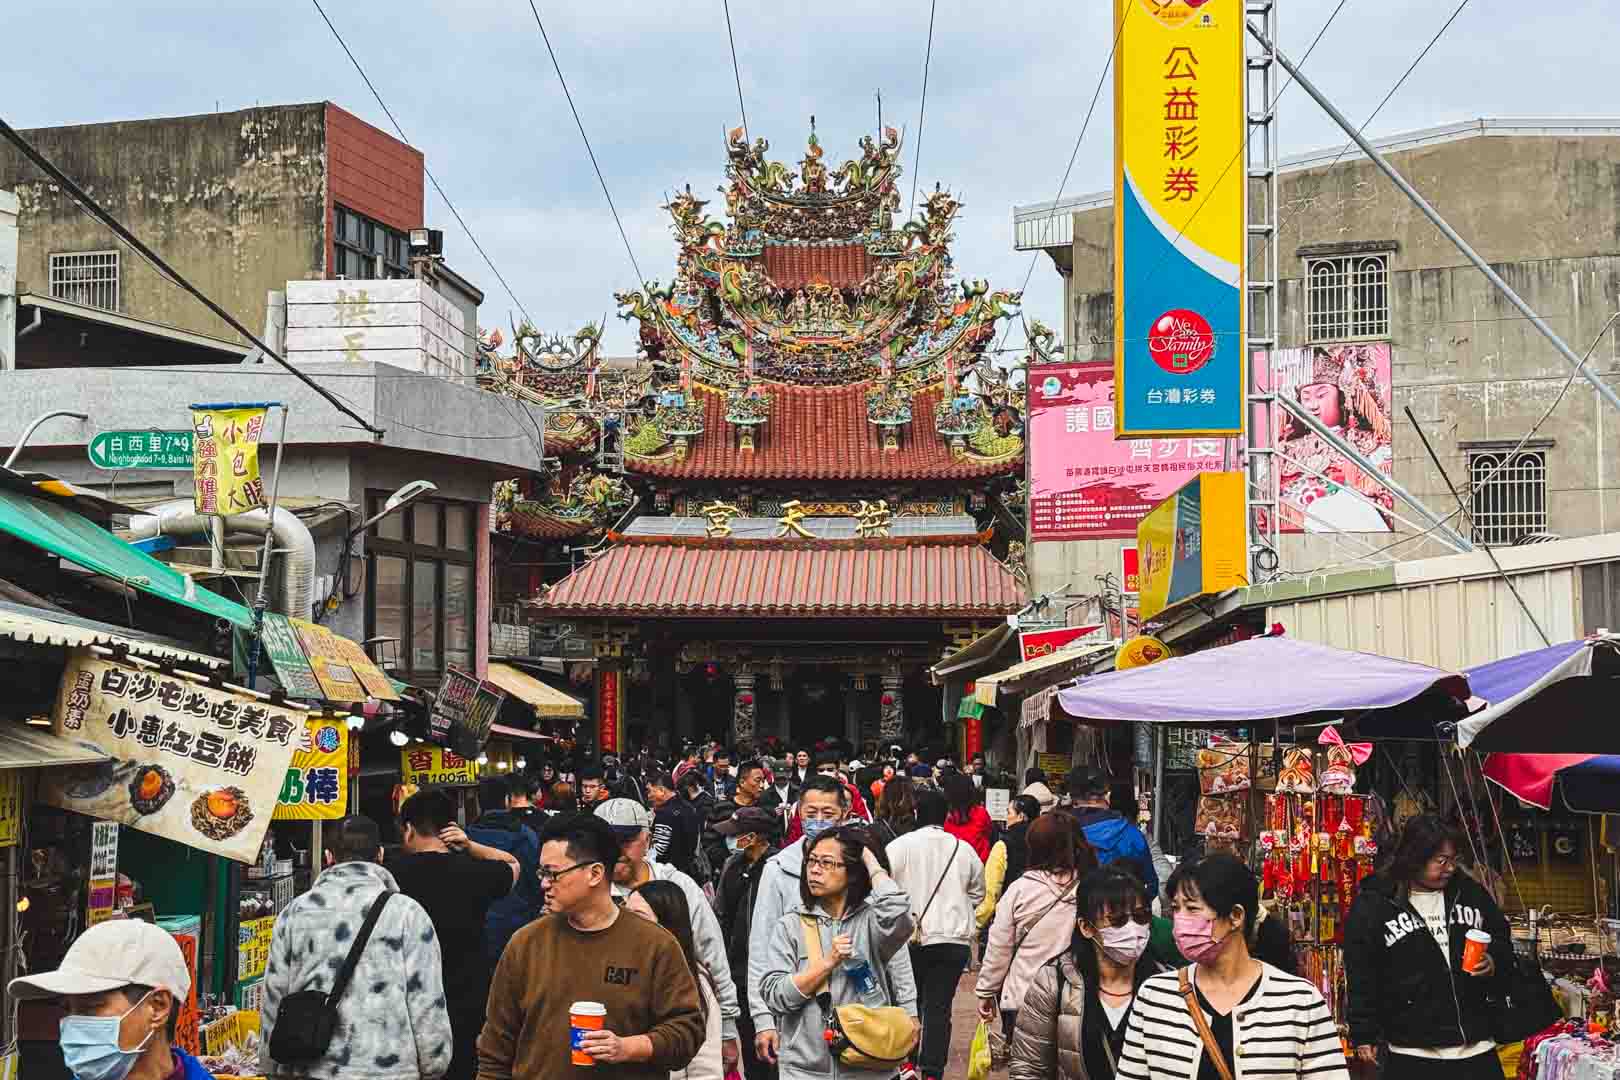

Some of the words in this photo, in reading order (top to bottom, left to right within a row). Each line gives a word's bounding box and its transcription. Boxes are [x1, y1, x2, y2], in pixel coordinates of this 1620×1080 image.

[1164, 46, 1199, 201] 公益彩券
[1149, 336, 1214, 360] Family
[1169, 318, 1190, 331] We
[1147, 388, 1216, 404] 台灣彩券
[198, 438, 218, 513] 強力推薦
[64, 670, 94, 731] 蛋奶素
[100, 667, 296, 746] 白沙屯必吃美食
[106, 708, 257, 776] 小惠紅豆餅
[604, 966, 633, 985] CAT
